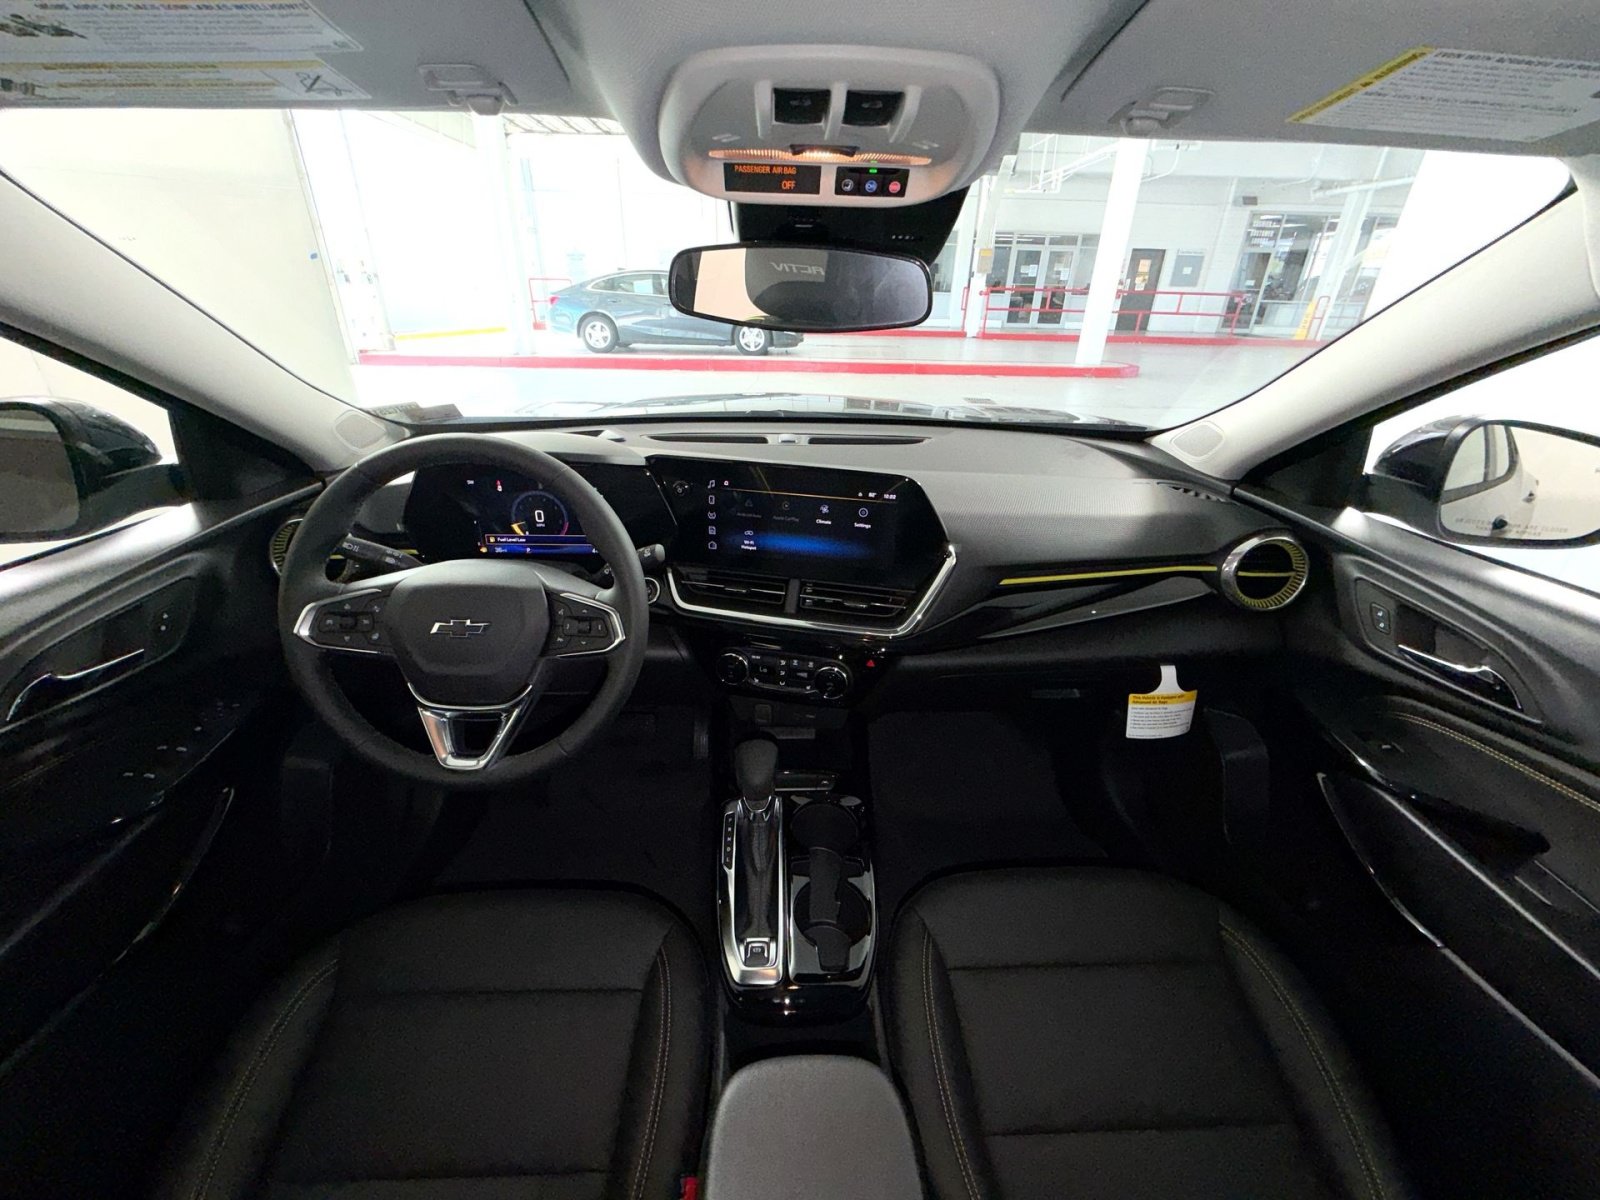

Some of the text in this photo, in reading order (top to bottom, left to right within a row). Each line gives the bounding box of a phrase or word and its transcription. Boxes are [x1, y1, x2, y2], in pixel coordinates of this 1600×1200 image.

[734, 165, 797, 175] PASSENGER AIR BAG
[781, 180, 796, 190] OFF
[534, 510, 544, 522] 0
